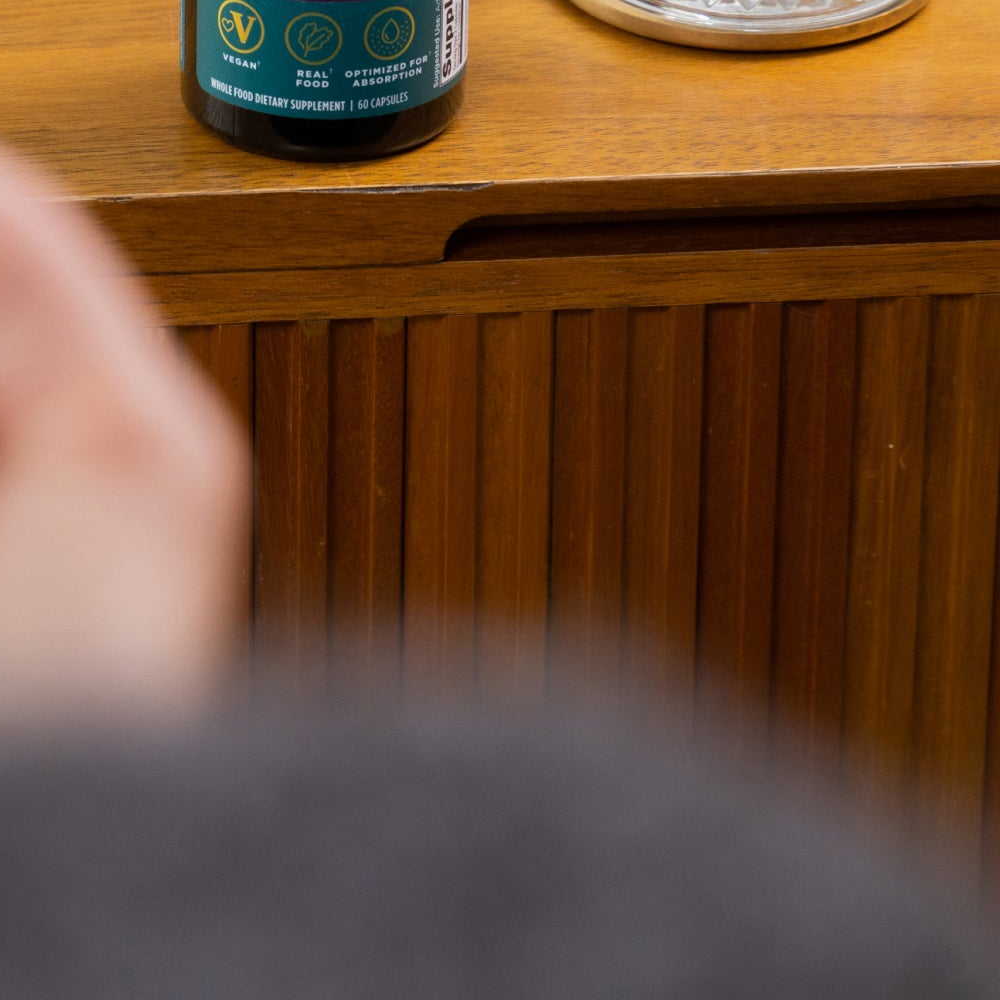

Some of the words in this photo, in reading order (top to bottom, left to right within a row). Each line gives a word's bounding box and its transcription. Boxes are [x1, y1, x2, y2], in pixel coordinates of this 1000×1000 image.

[344, 62, 407, 78] OPTIMIZED
[433, 37, 441, 89] Suggested
[295, 79, 330, 88] FOOD
[352, 66, 423, 88] ABSORPTION
[210, 76, 233, 96] WHOLE
[233, 86, 254, 102] FOOD
[254, 93, 289, 108] DIETARY
[290, 98, 346, 112] SUPPLEMENT
[357, 99, 369, 110] 60
[370, 91, 409, 108] CAPSULES
